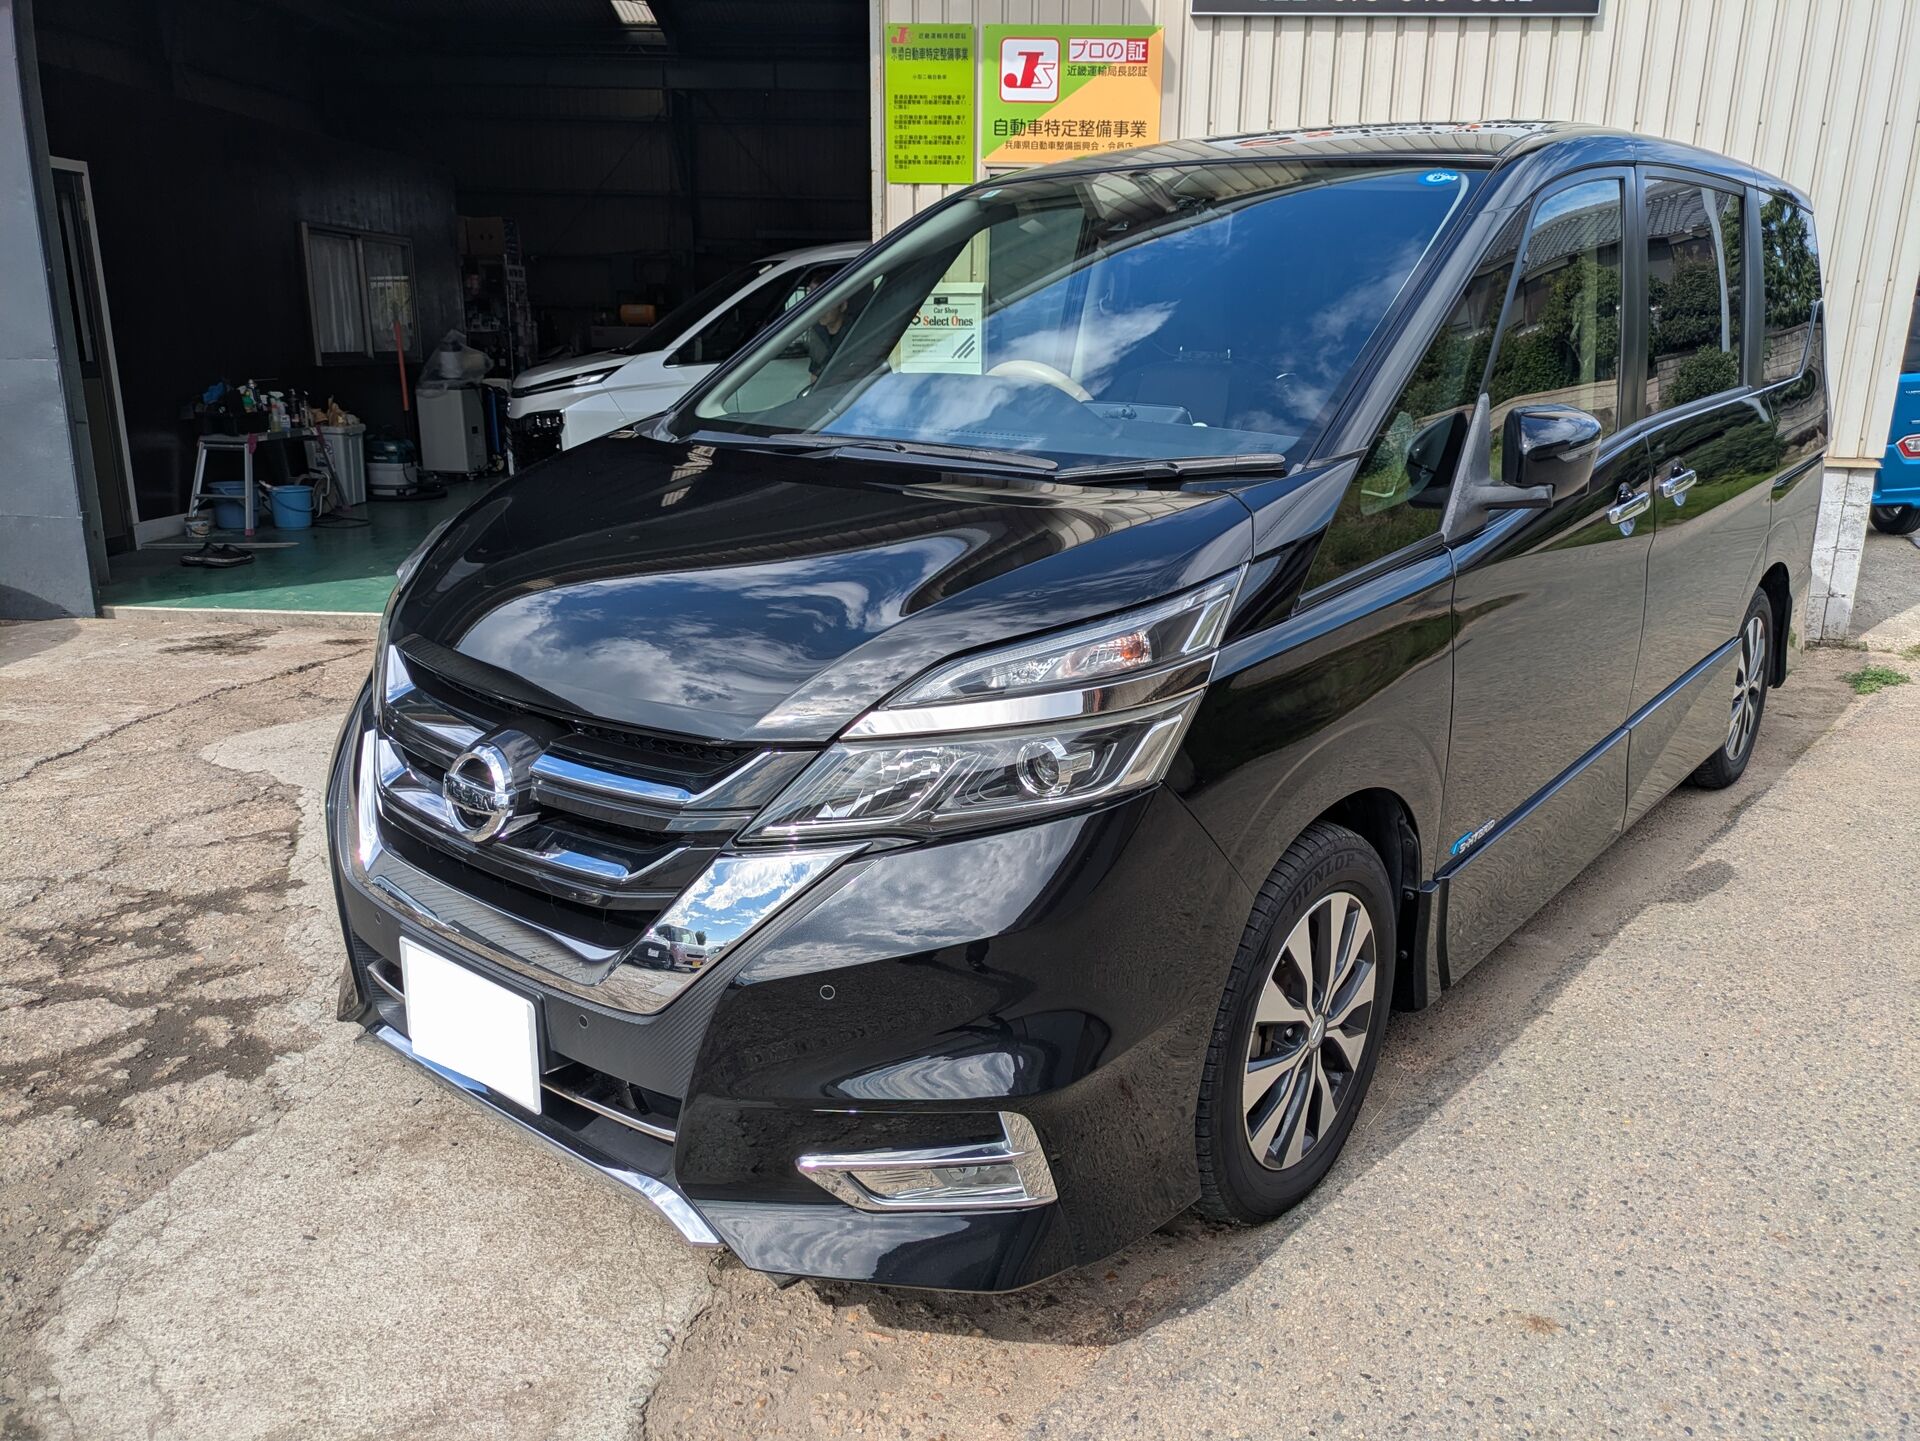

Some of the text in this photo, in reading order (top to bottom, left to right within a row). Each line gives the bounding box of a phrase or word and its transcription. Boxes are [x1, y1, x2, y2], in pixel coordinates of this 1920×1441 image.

[1070, 40, 1147, 61] プロの証
[1066, 65, 1148, 77] 近畿運輸局長認証
[993, 118, 1147, 138] 自動車特定整備事業
[944, 307, 959, 315] Shop
[923, 315, 973, 326] Select Ones
[1291, 852, 1355, 912] DUNLOP
